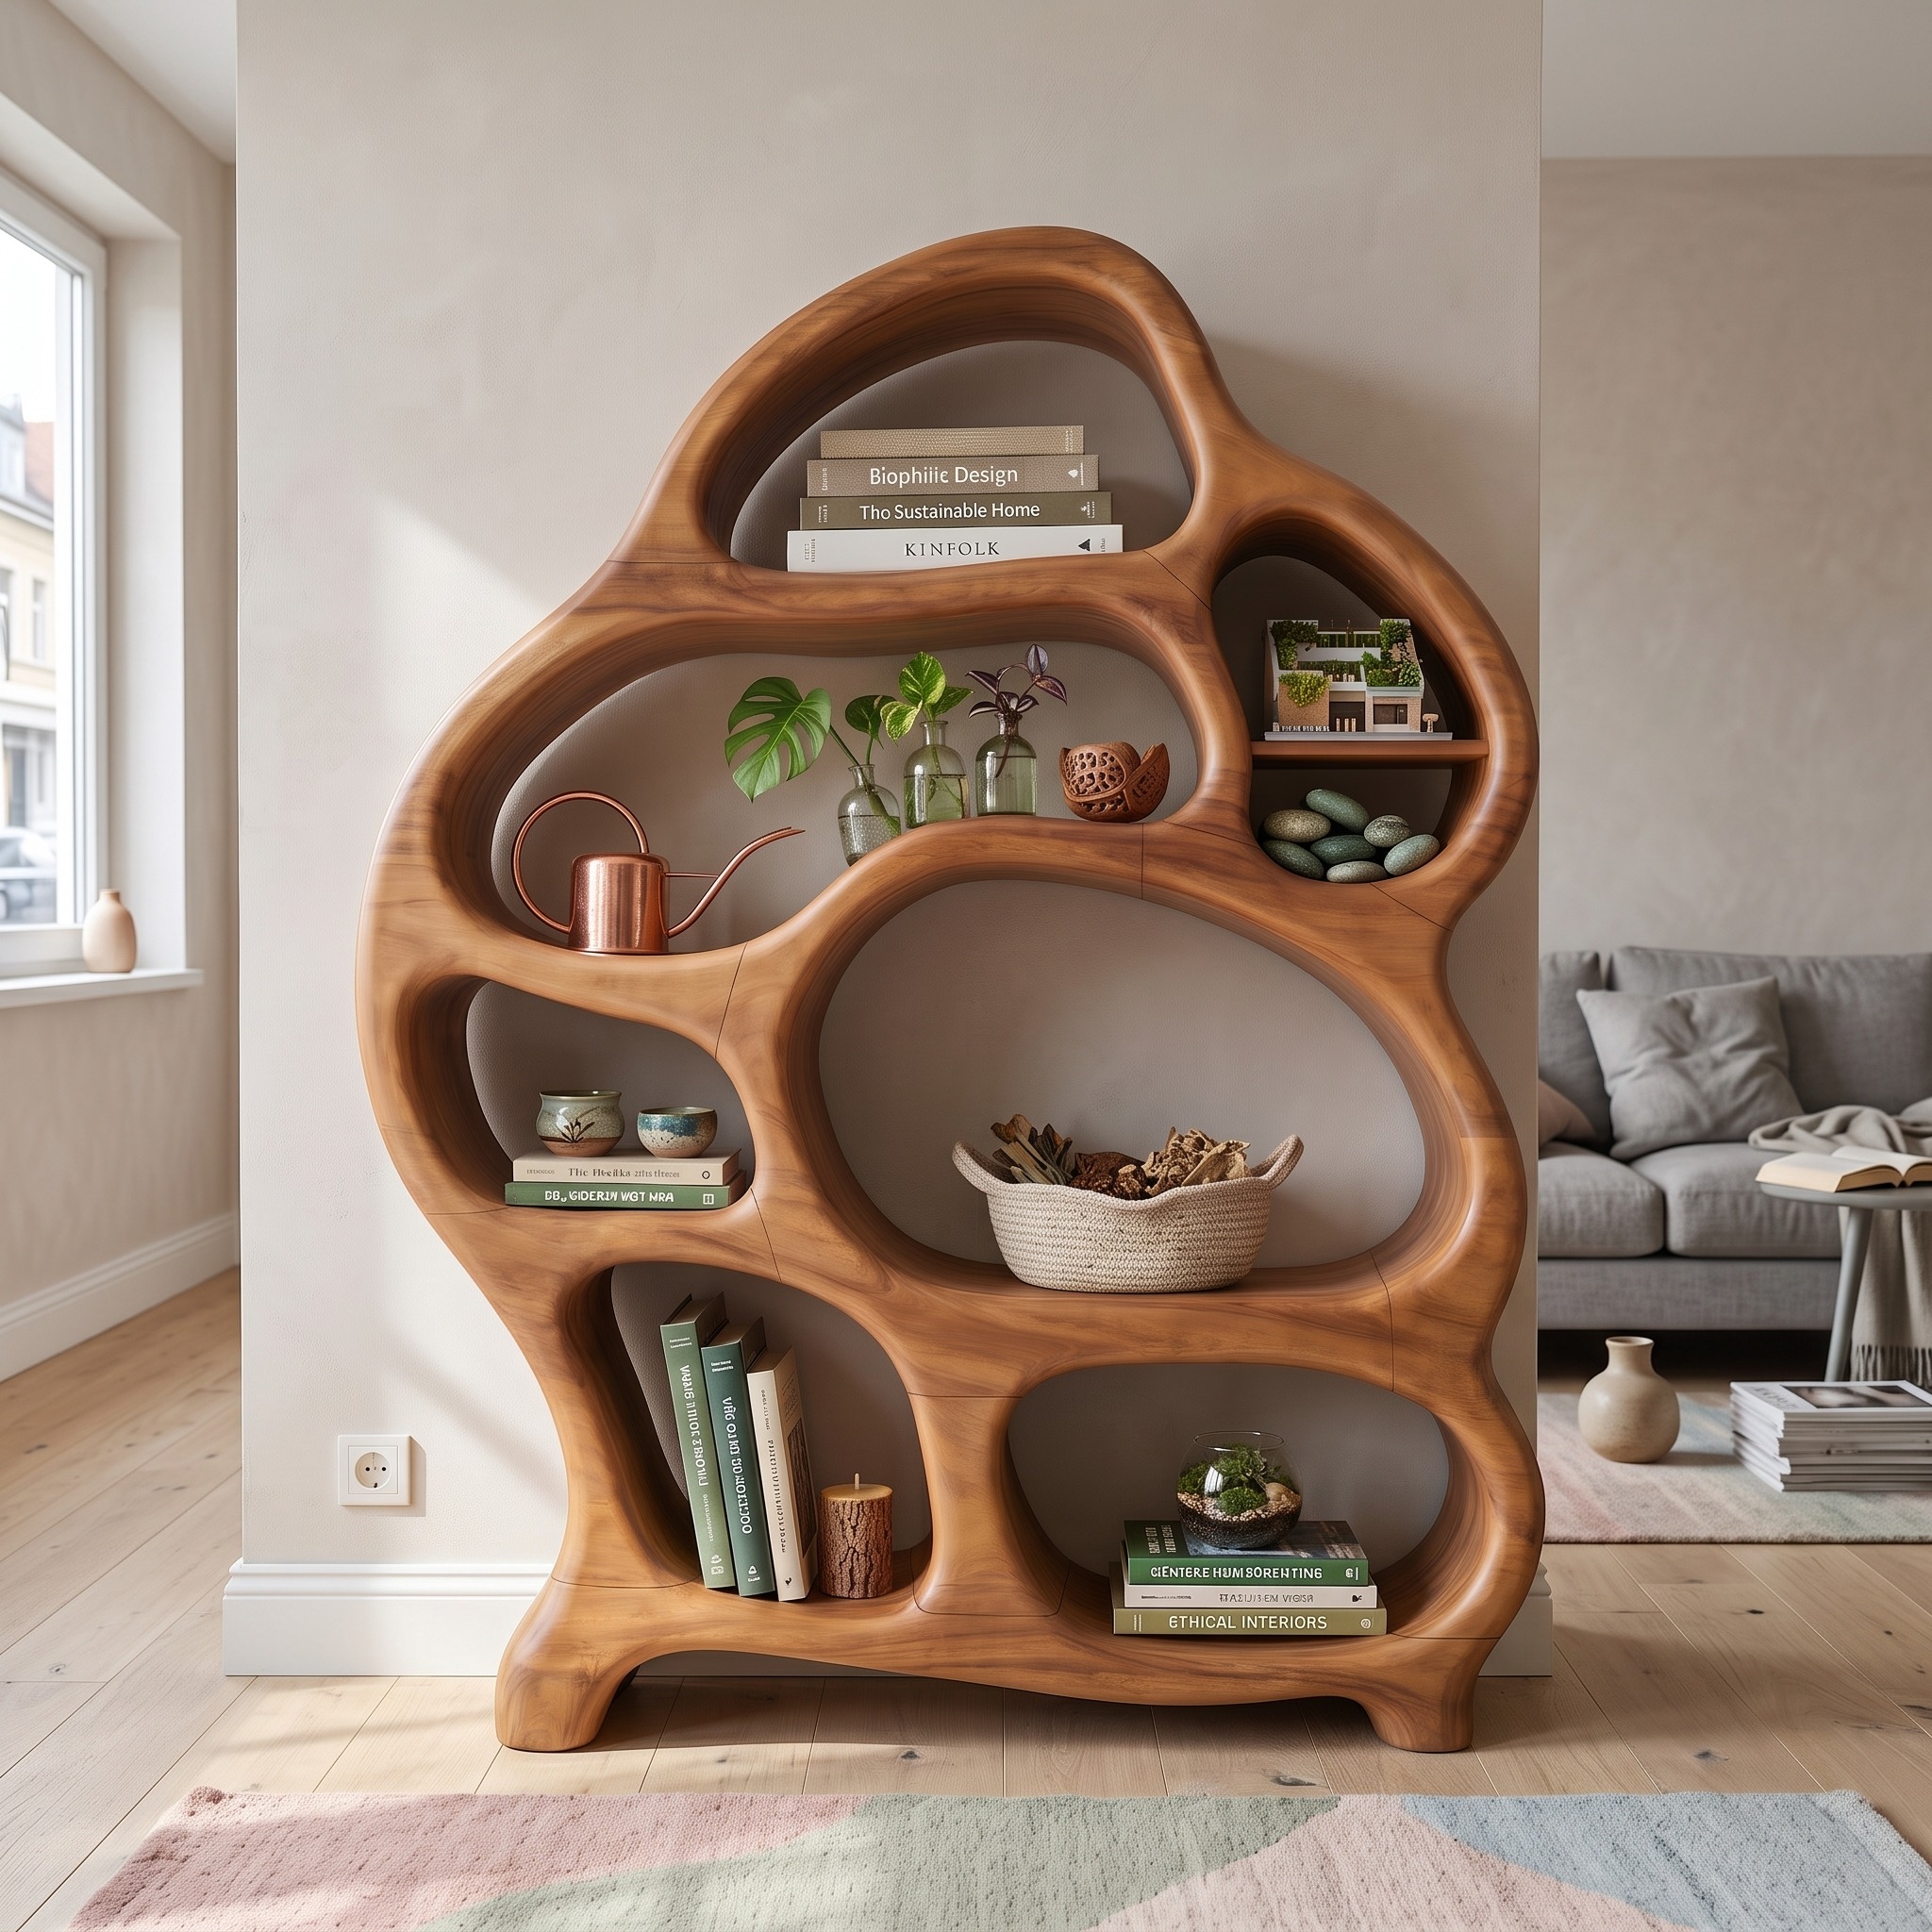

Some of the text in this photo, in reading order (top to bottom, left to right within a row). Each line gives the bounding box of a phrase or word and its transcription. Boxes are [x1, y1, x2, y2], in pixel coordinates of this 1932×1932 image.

[955, 465, 1018, 487] Design
[894, 502, 988, 520] Sustainable
[991, 502, 1041, 518] Home
[905, 541, 1000, 557] KINFOLK
[1168, 1615, 1327, 1629] ETHICAL INTERIORS
